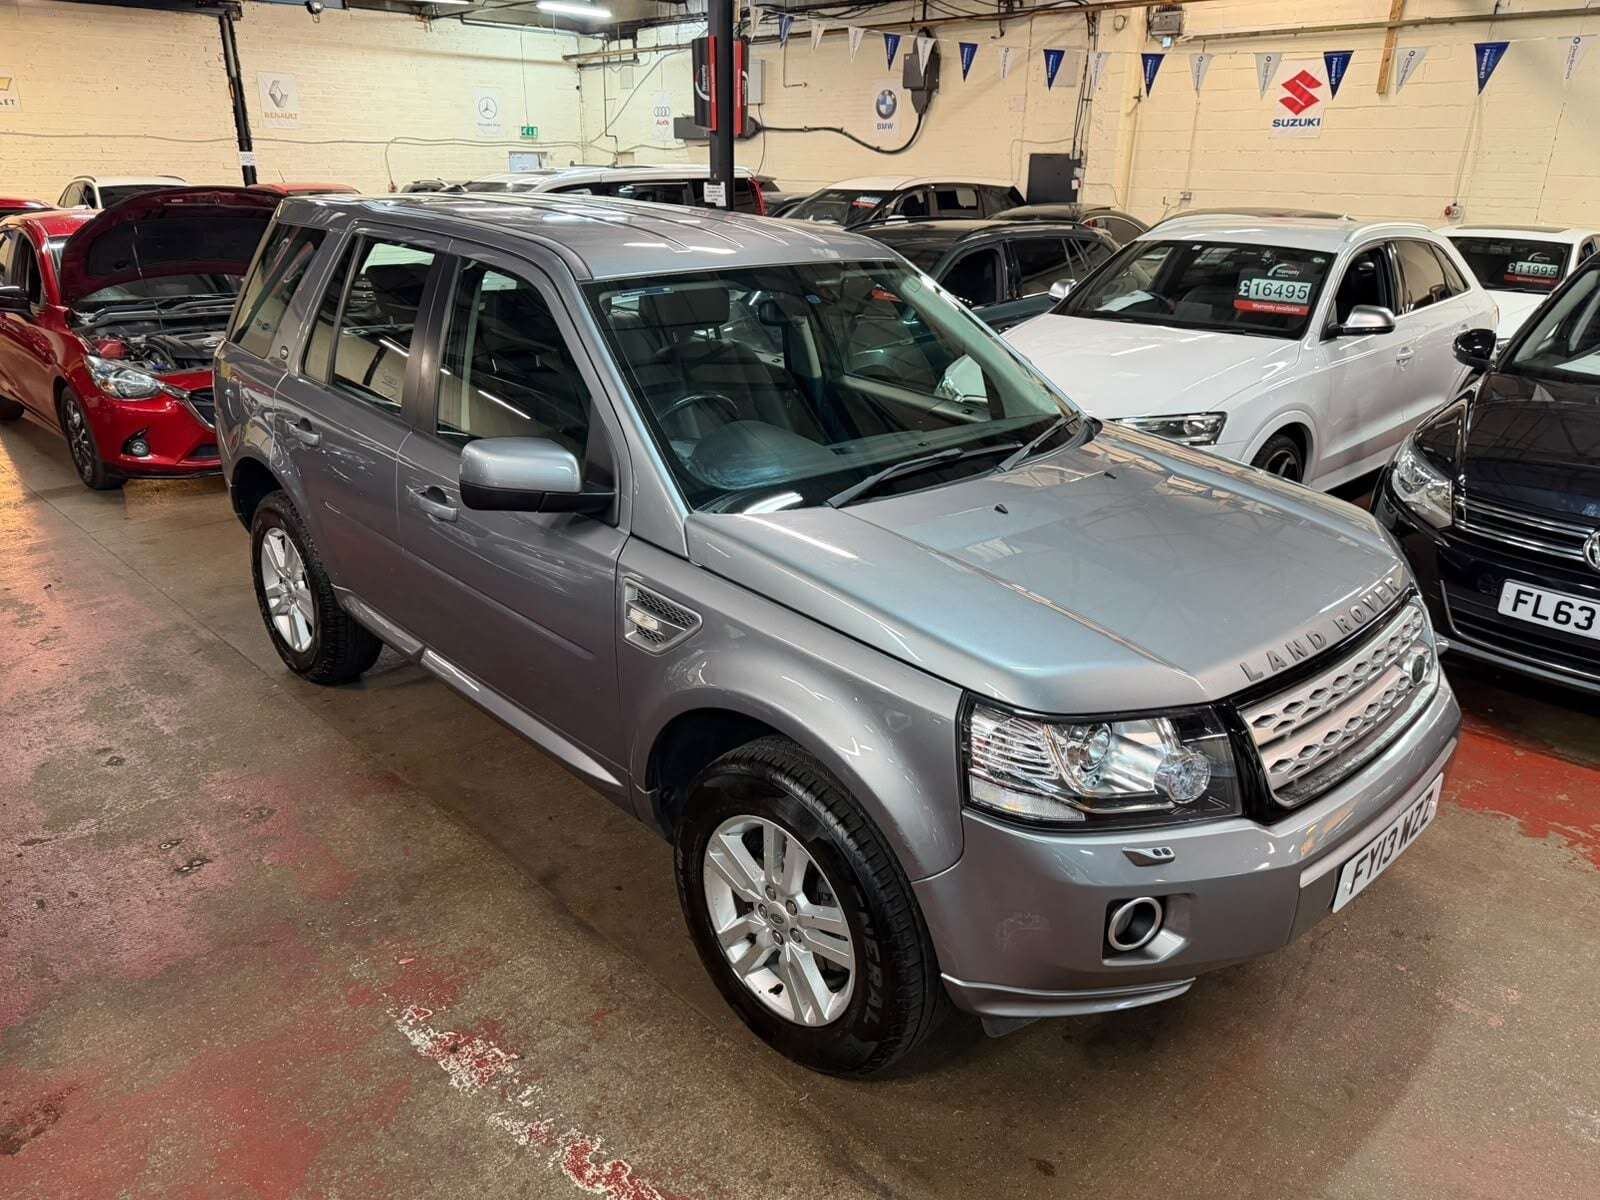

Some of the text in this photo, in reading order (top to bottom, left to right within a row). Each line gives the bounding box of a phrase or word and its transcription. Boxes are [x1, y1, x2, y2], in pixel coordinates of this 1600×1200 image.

[263, 112, 298, 120] RENAULT
[1272, 117, 1321, 128] SUZUKI
[876, 122, 894, 130] BMW
[1507, 262, 1557, 277] £11995
[1238, 280, 1309, 301] £16495
[1511, 588, 1596, 631] FL63
[1239, 577, 1400, 682] LAND ROVER
[1348, 826, 1399, 895] FY13
